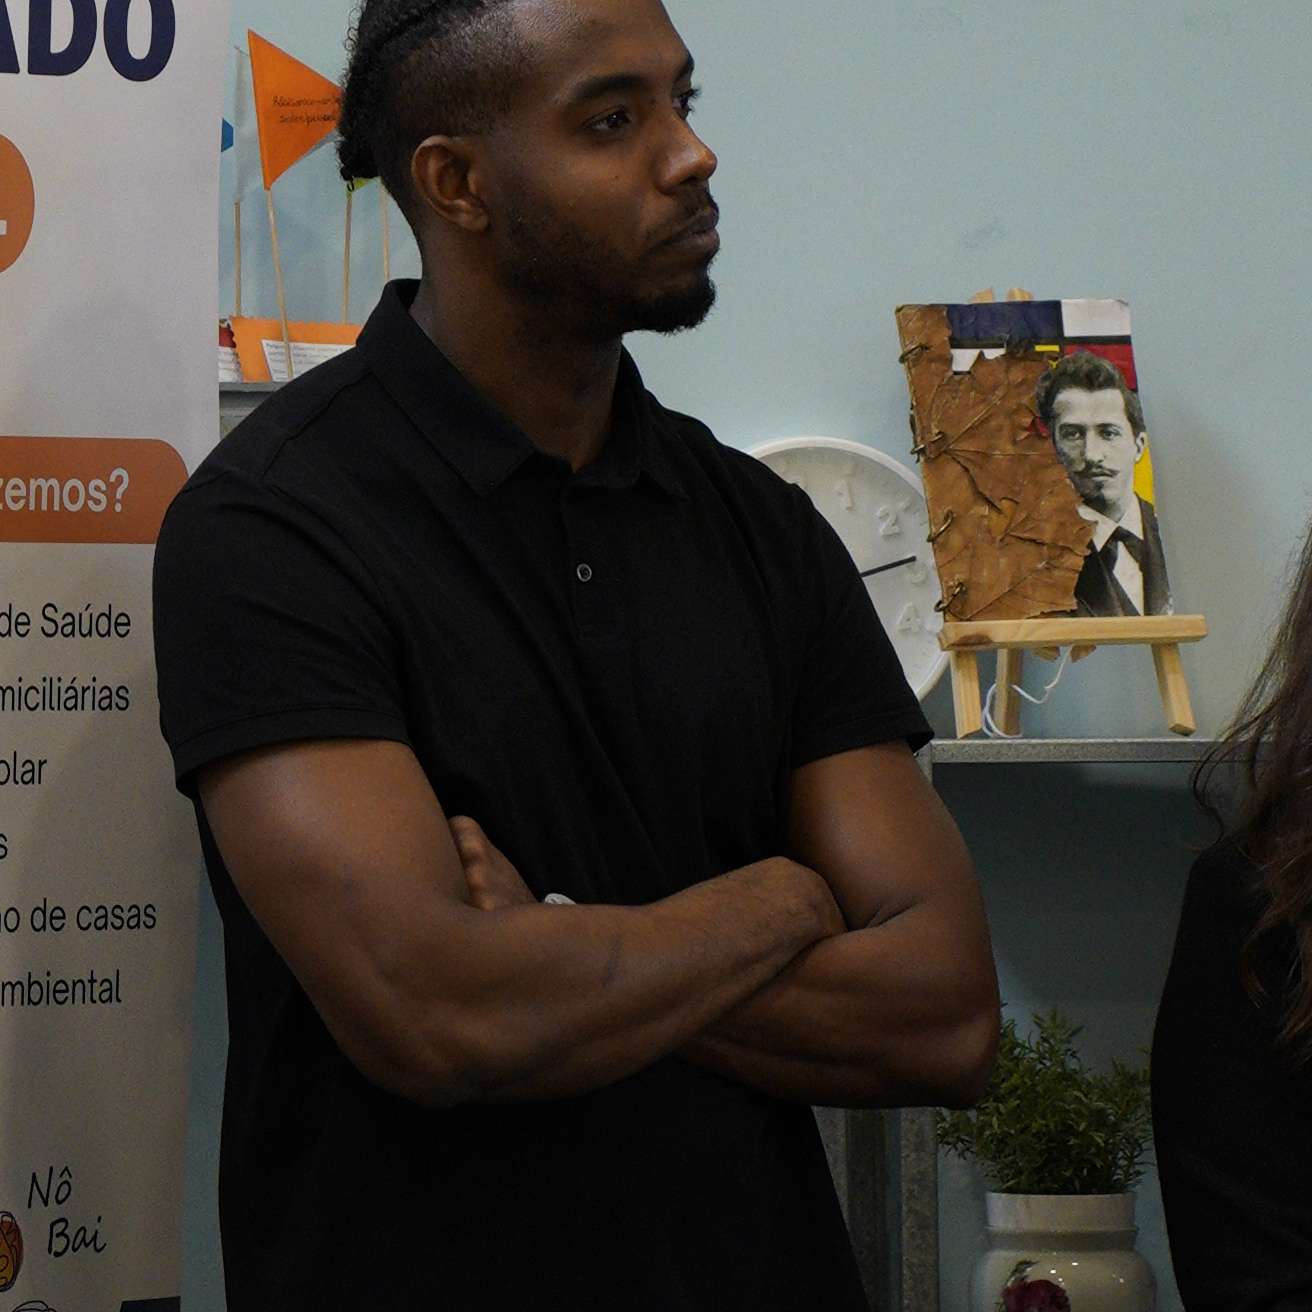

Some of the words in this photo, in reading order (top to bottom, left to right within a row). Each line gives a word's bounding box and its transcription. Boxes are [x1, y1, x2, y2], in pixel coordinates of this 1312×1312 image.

[40, 601, 132, 639] Saúde
[29, 897, 67, 933] de
[75, 901, 157, 931] casas
[27, 1165, 73, 1209] Nô
[47, 1215, 107, 1258] Bai
